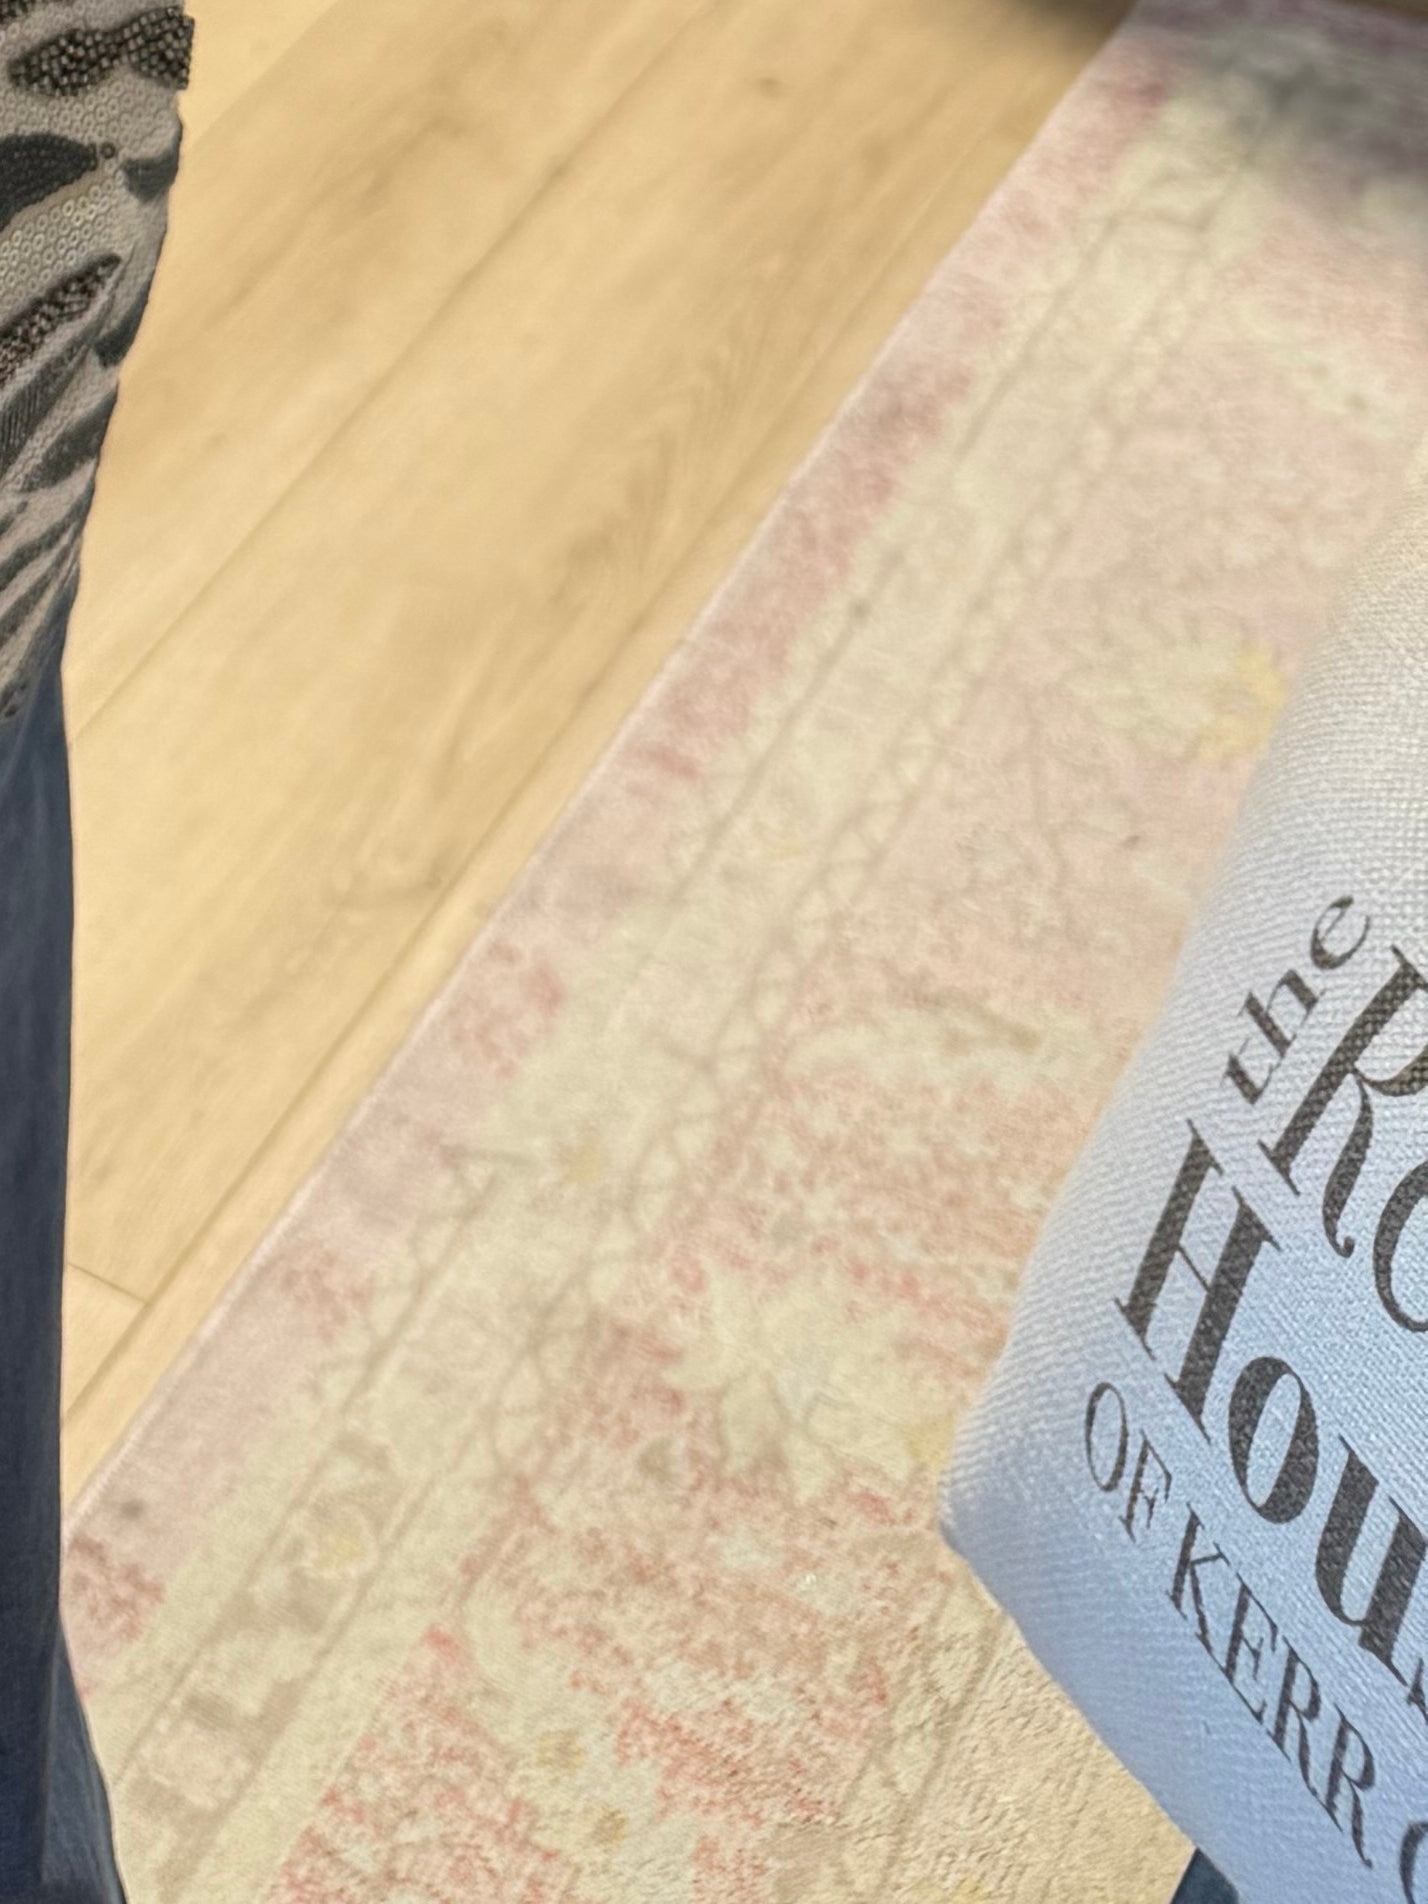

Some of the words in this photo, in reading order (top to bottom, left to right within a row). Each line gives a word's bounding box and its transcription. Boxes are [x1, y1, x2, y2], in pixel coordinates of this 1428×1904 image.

[1219, 894, 1371, 1105] the
[1084, 1382, 1172, 1542] OF
[1114, 1118, 1428, 1722] Hou
